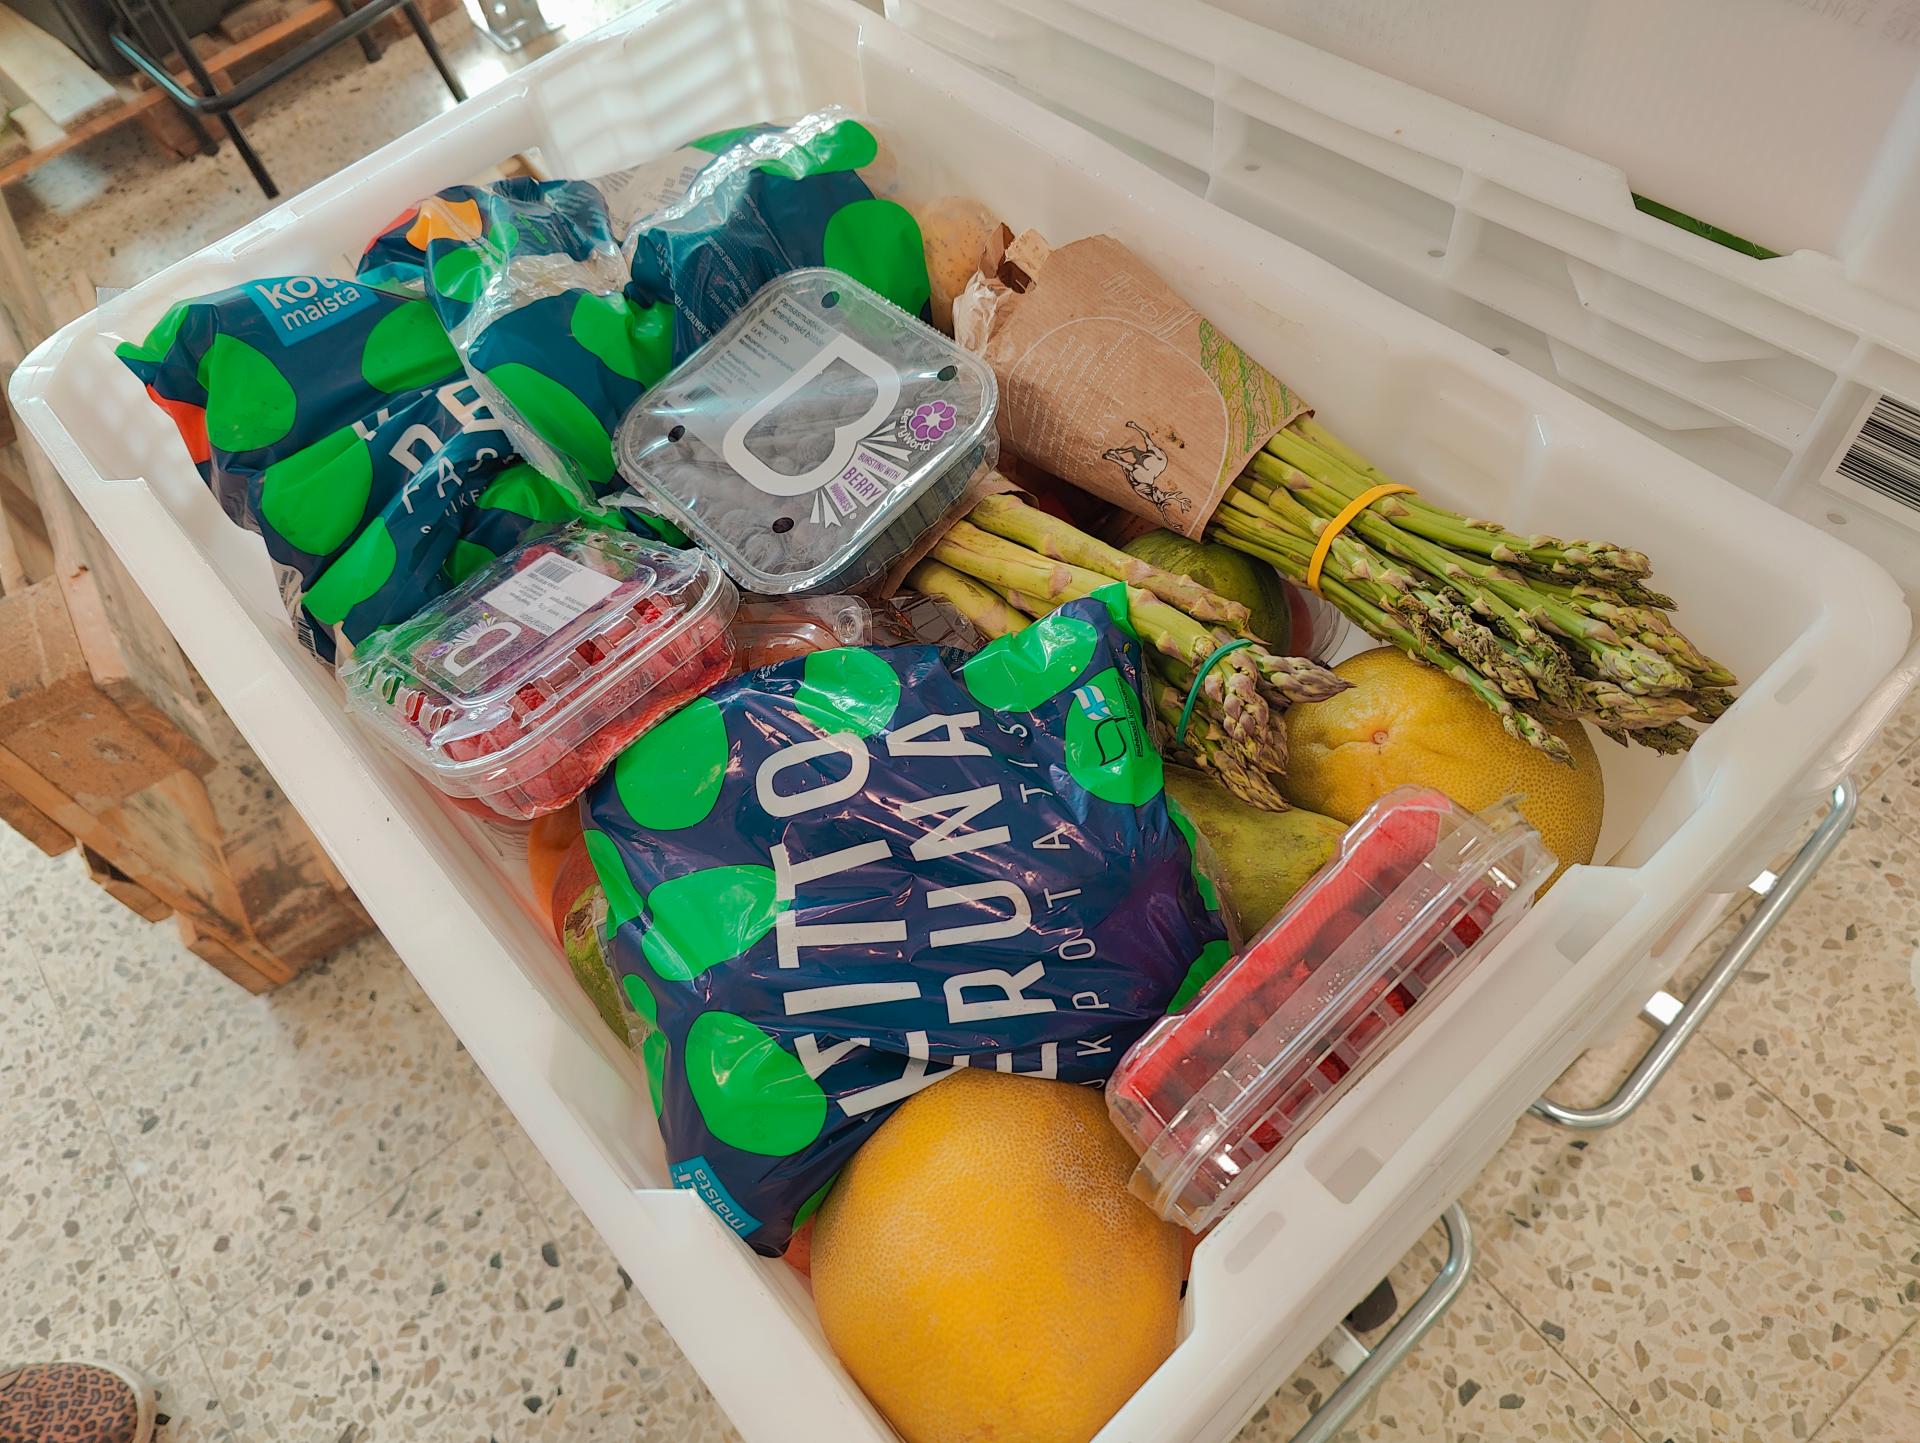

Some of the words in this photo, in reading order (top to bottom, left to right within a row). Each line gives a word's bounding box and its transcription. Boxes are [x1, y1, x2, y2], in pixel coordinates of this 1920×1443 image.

[255, 274, 344, 310] kot
[281, 286, 361, 331] maista
[842, 466, 882, 501] BERRY
[886, 709, 1058, 1080] ERUNA
[694, 1168, 746, 1230] maista
